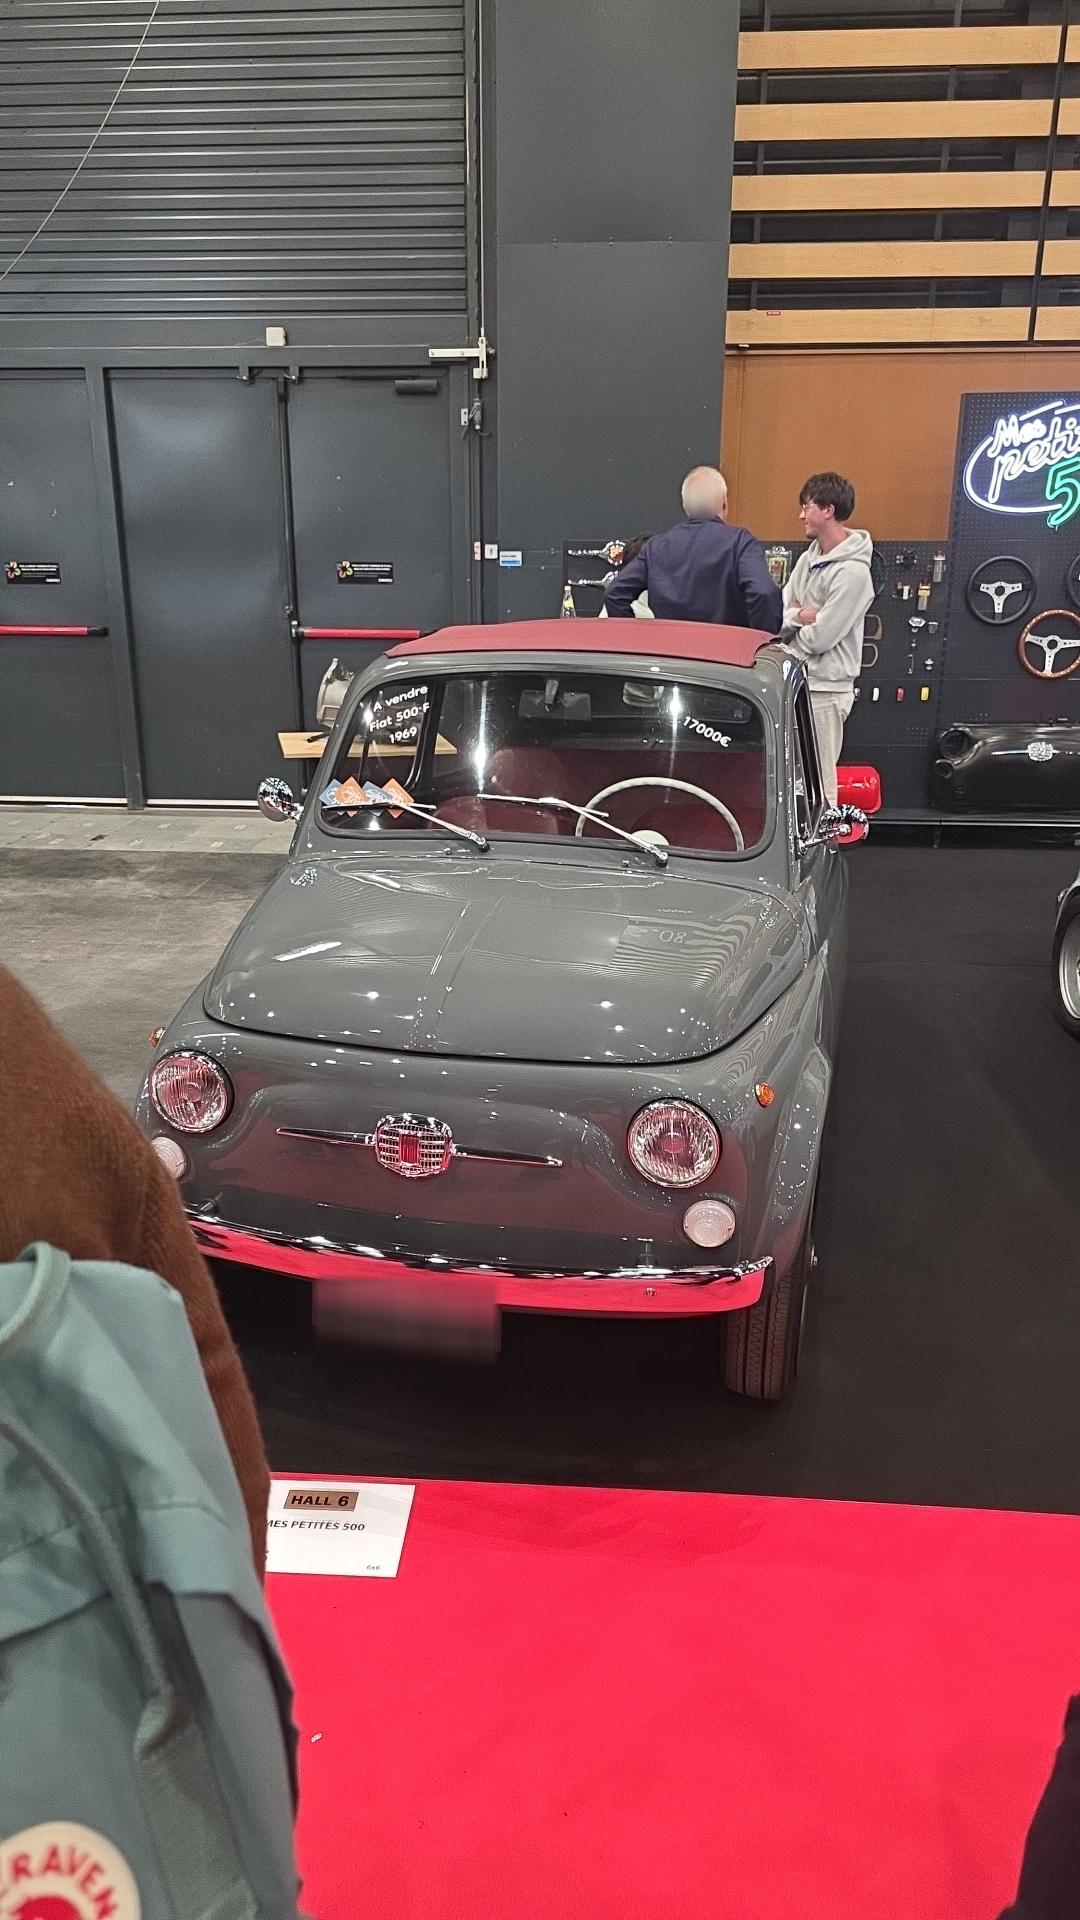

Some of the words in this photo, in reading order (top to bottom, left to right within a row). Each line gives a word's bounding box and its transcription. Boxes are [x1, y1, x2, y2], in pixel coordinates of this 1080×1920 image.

[987, 414, 1047, 458] Mes
[988, 417, 1080, 504] peti
[373, 701, 382, 712] A
[385, 686, 428, 707] vendre
[369, 716, 392, 732] Fiat
[683, 716, 732, 747] 17000€
[389, 727, 417, 743] 1969
[290, 1495, 333, 1506] HALL
[337, 1496, 350, 1507] 6
[291, 1521, 340, 1530] PETITES
[341, 1523, 366, 1531] 500
